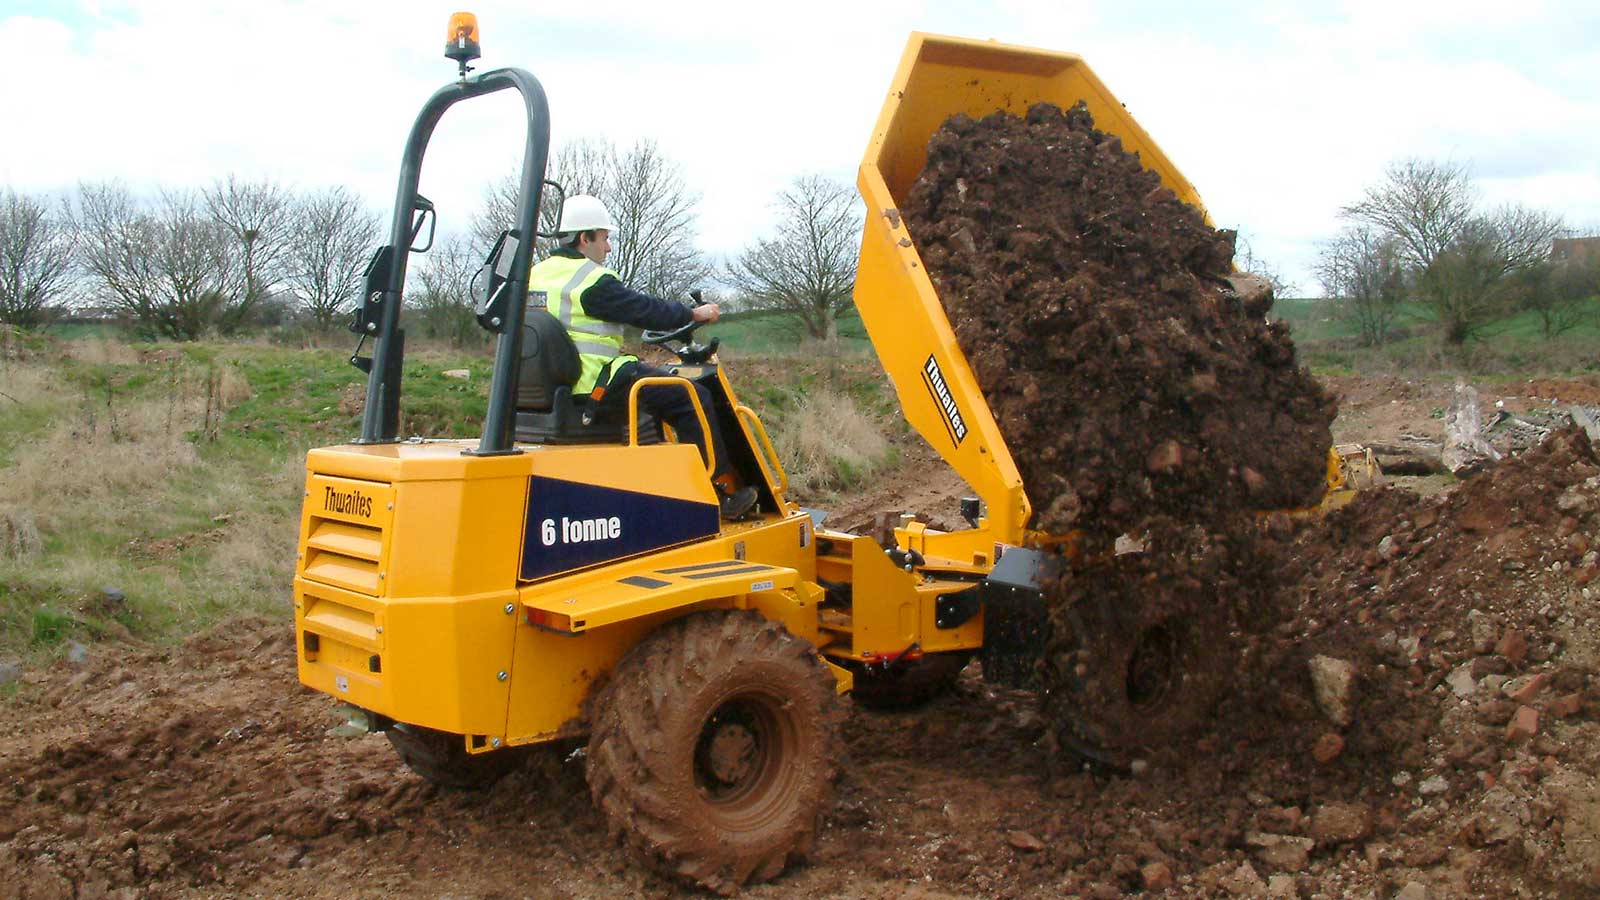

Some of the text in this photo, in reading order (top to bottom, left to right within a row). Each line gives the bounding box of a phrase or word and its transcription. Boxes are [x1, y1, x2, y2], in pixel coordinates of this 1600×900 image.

[926, 356, 966, 439] Thwaites
[324, 486, 373, 518] Thwaites
[541, 516, 621, 546] 6 tonne
